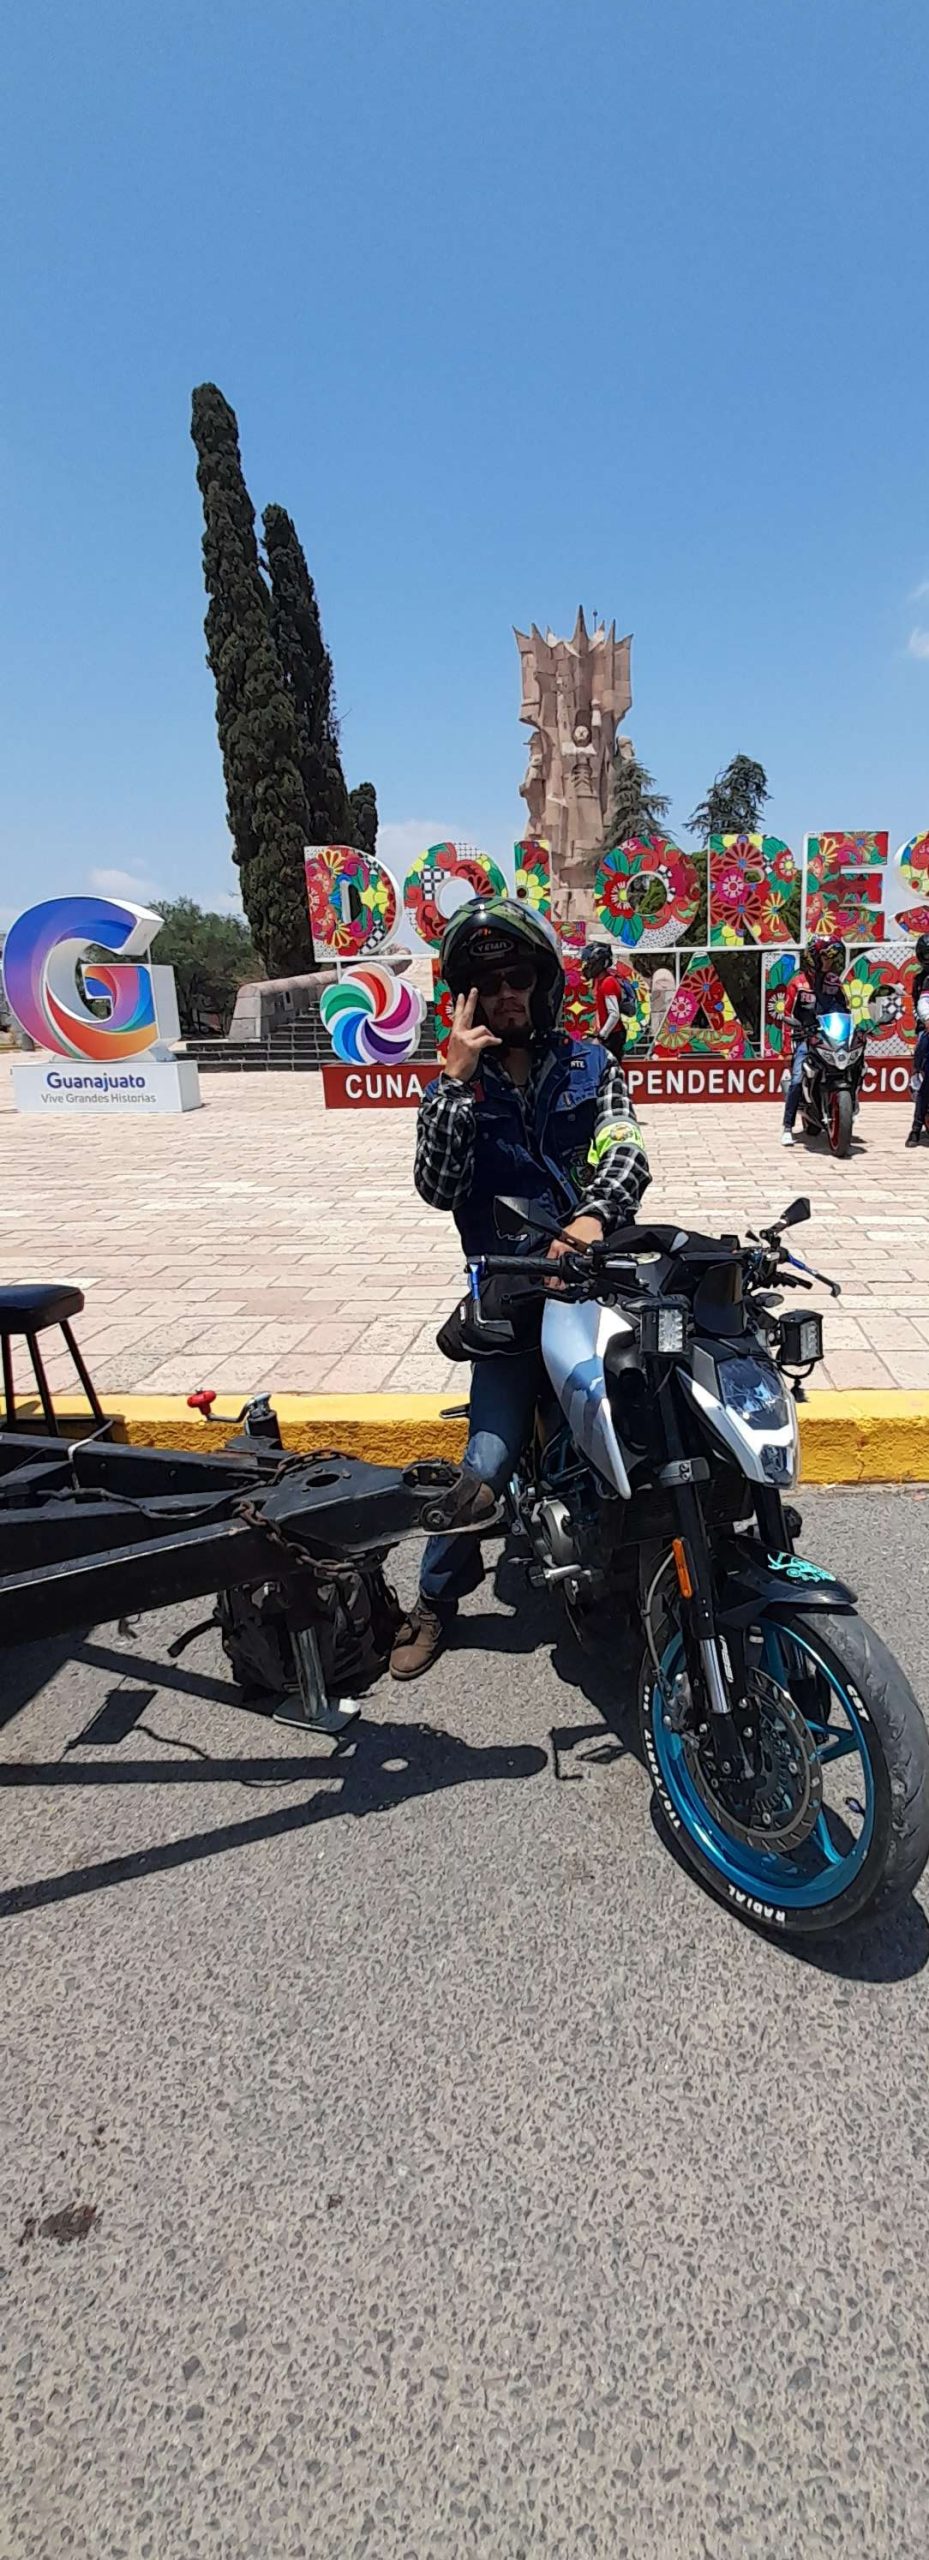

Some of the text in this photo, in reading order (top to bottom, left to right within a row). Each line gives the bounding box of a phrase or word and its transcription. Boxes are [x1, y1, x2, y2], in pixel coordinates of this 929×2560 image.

[46, 1072, 146, 1092] Guanajuato
[345, 1073, 425, 1099] CUNA
[41, 1093, 157, 1103] Vive Grandes Historias
[728, 1884, 786, 1922] RADIAL
